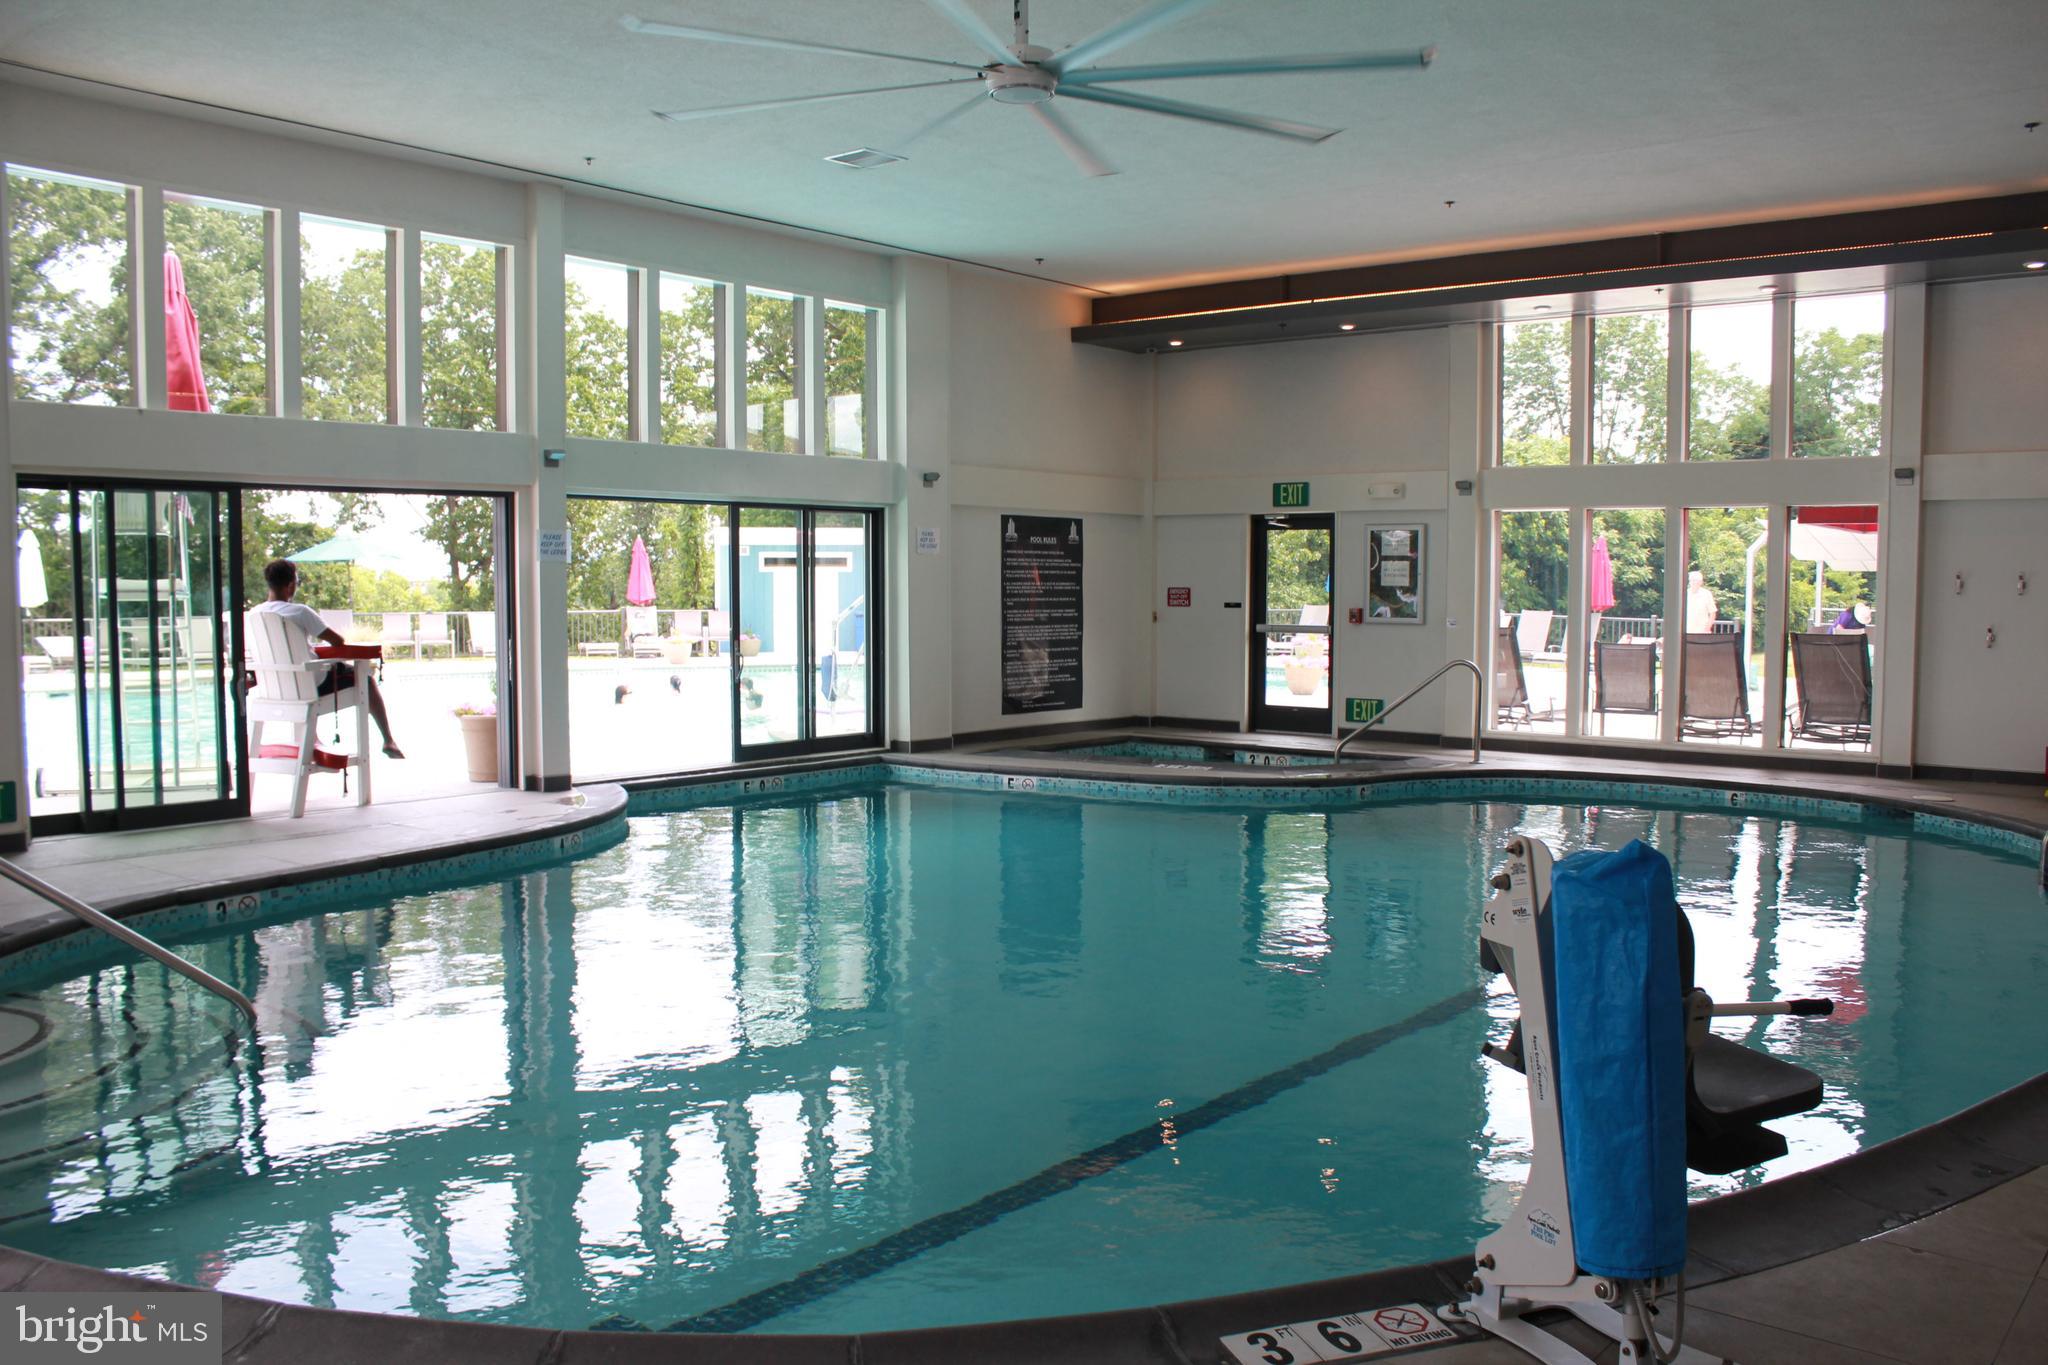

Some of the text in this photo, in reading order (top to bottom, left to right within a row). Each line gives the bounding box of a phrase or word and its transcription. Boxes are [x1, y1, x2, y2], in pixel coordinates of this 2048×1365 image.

[1280, 483, 1304, 505] EXIT
[1030, 536, 1057, 544] POOL RULES
[1353, 699, 1378, 720] EXIT
[1247, 1316, 1362, 1365] 3 FT 6 IN
[1390, 1329, 1453, 1347] NO DIVING
